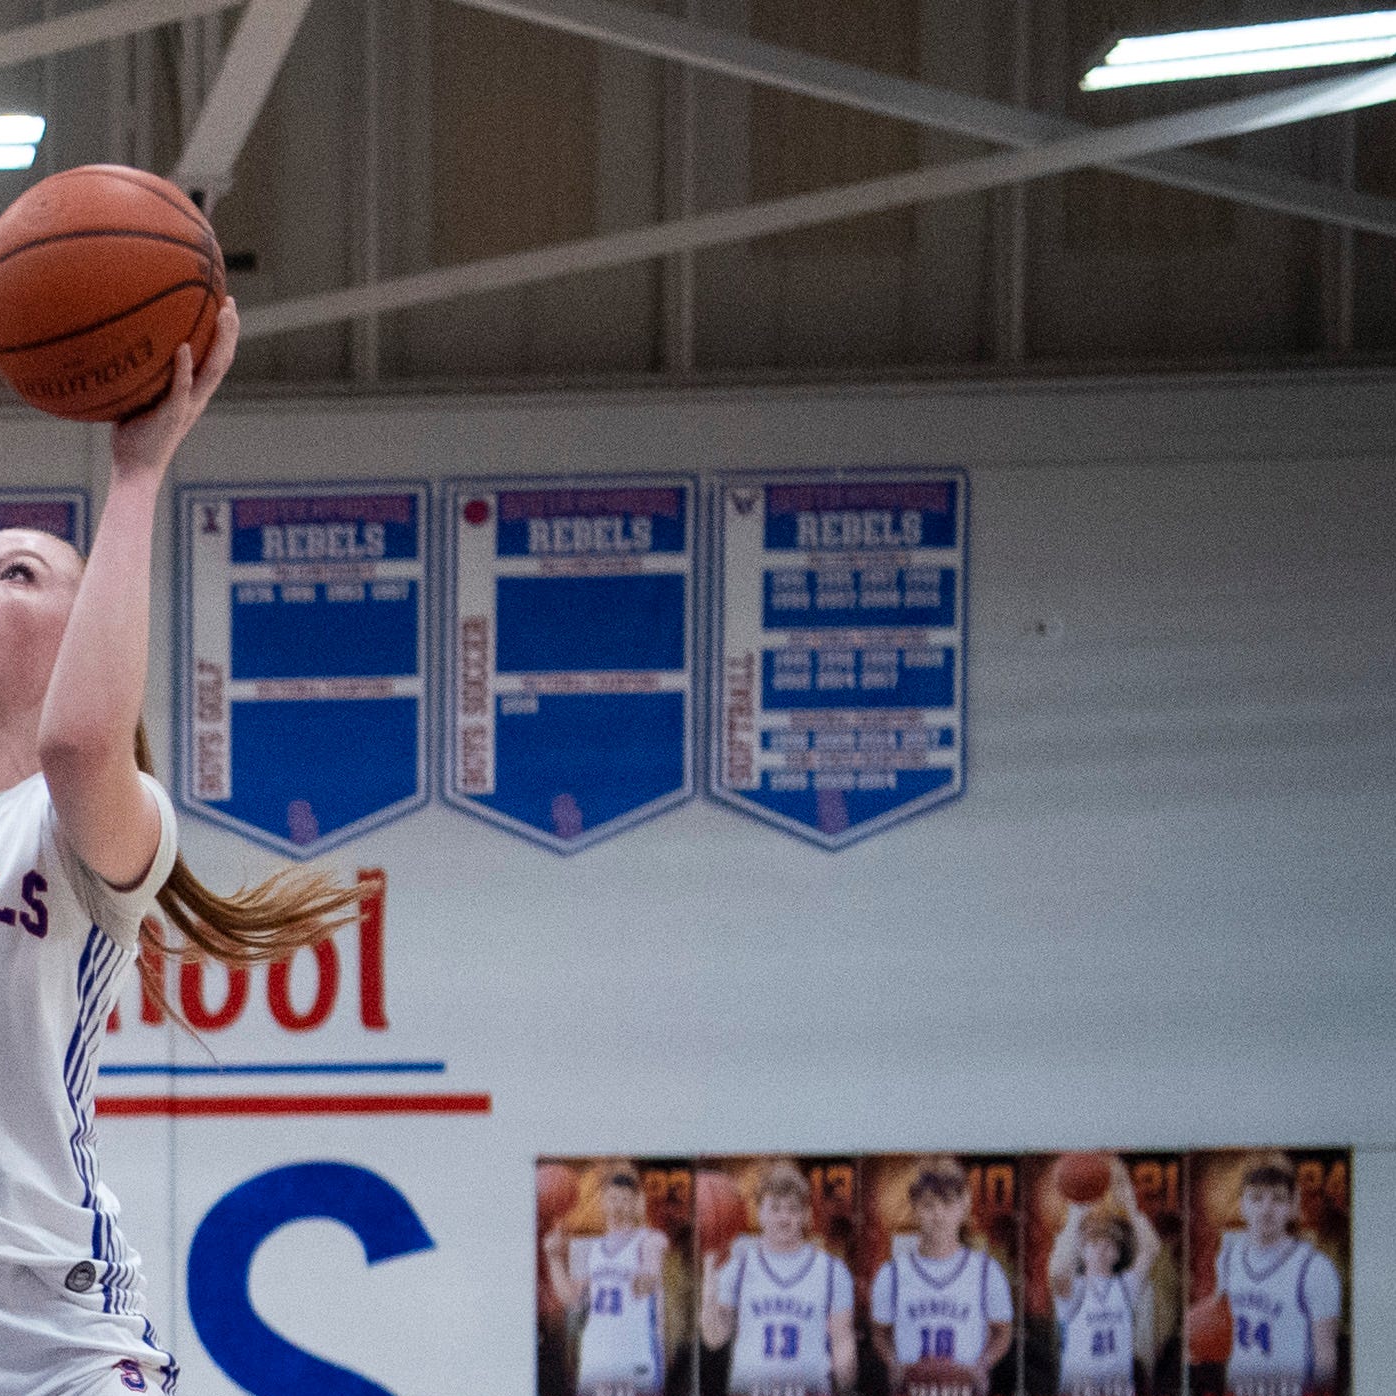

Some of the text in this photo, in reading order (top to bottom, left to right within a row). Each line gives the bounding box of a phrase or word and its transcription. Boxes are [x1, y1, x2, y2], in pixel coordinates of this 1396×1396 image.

[263, 523, 385, 559] REBELS
[529, 516, 653, 553] REBELS
[795, 510, 923, 547] REBELS
